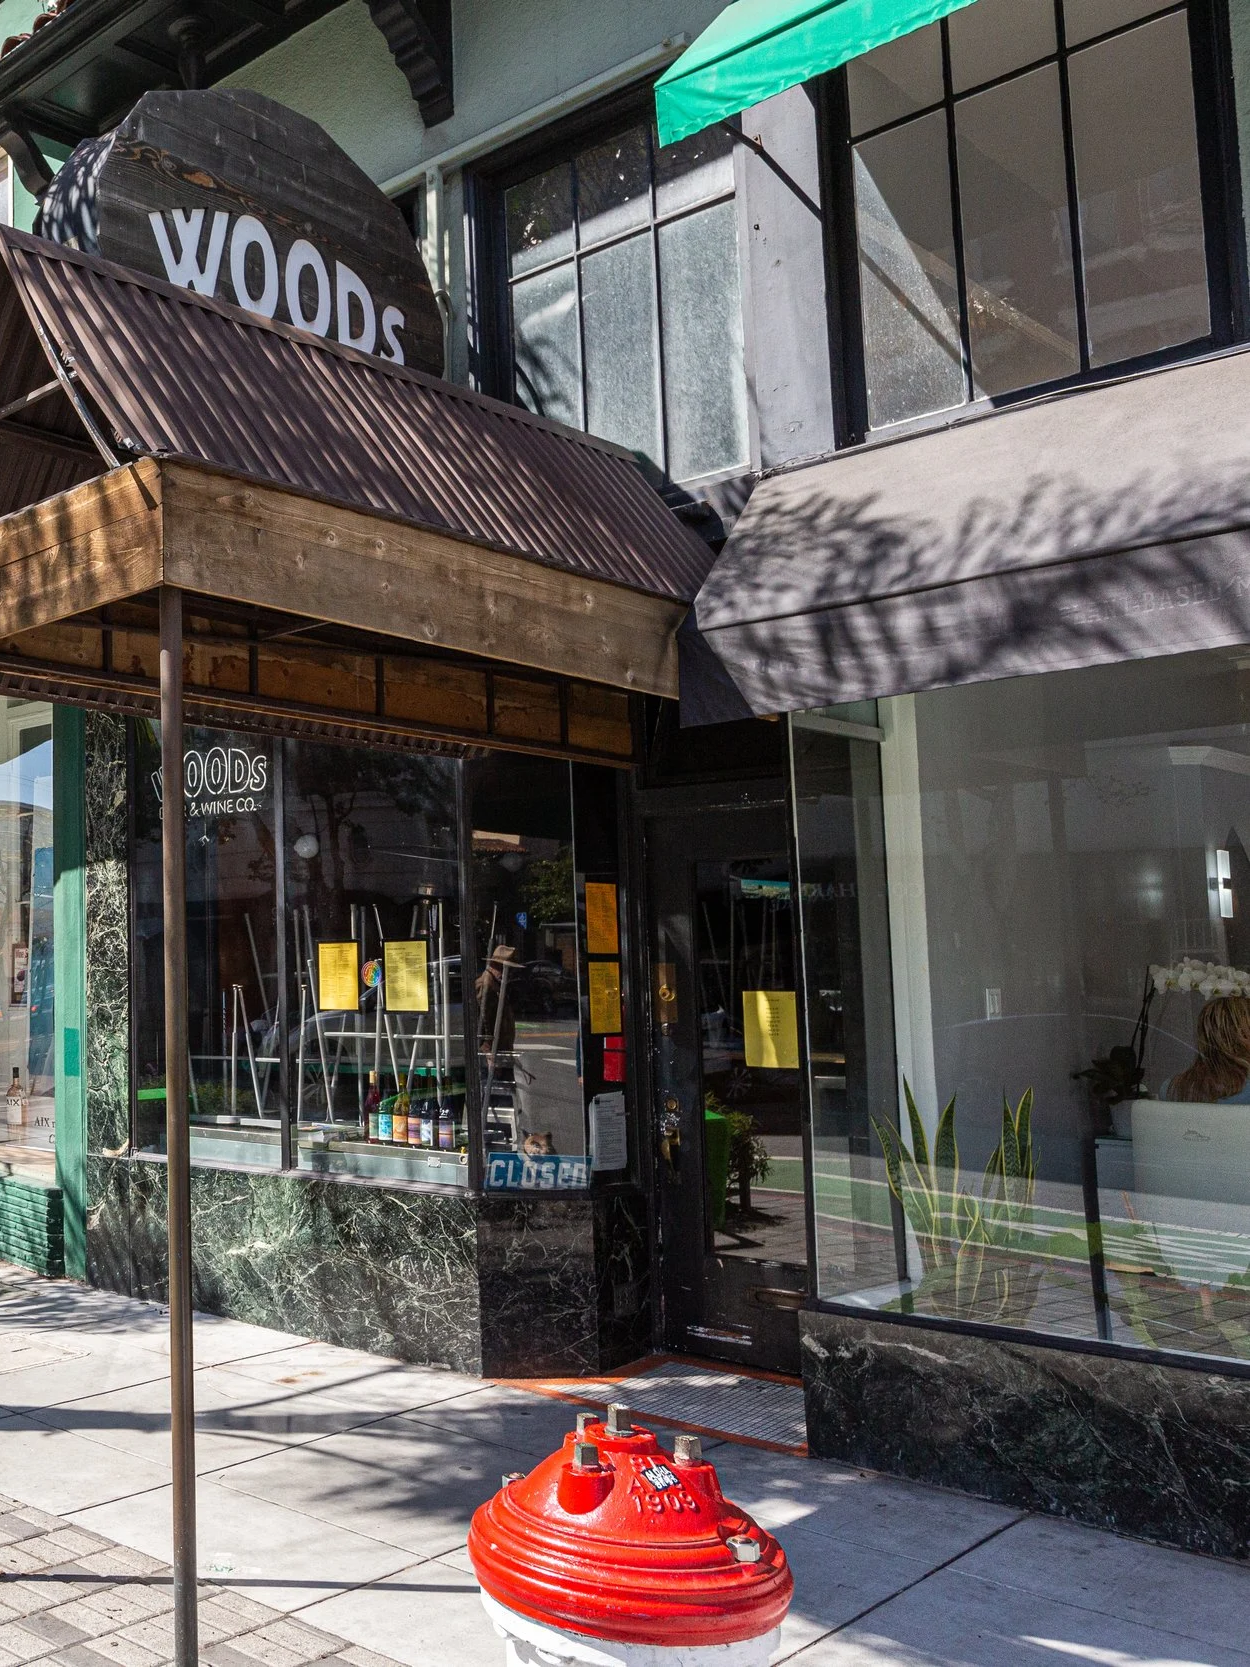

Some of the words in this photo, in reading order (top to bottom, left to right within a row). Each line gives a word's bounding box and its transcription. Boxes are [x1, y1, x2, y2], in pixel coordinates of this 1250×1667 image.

[190, 802, 200, 817] &
[201, 800, 233, 815] WINE
[34, 1117, 50, 1128] AIX
[489, 1159, 588, 1189] CLOSED
[632, 1491, 696, 1513] 1909
